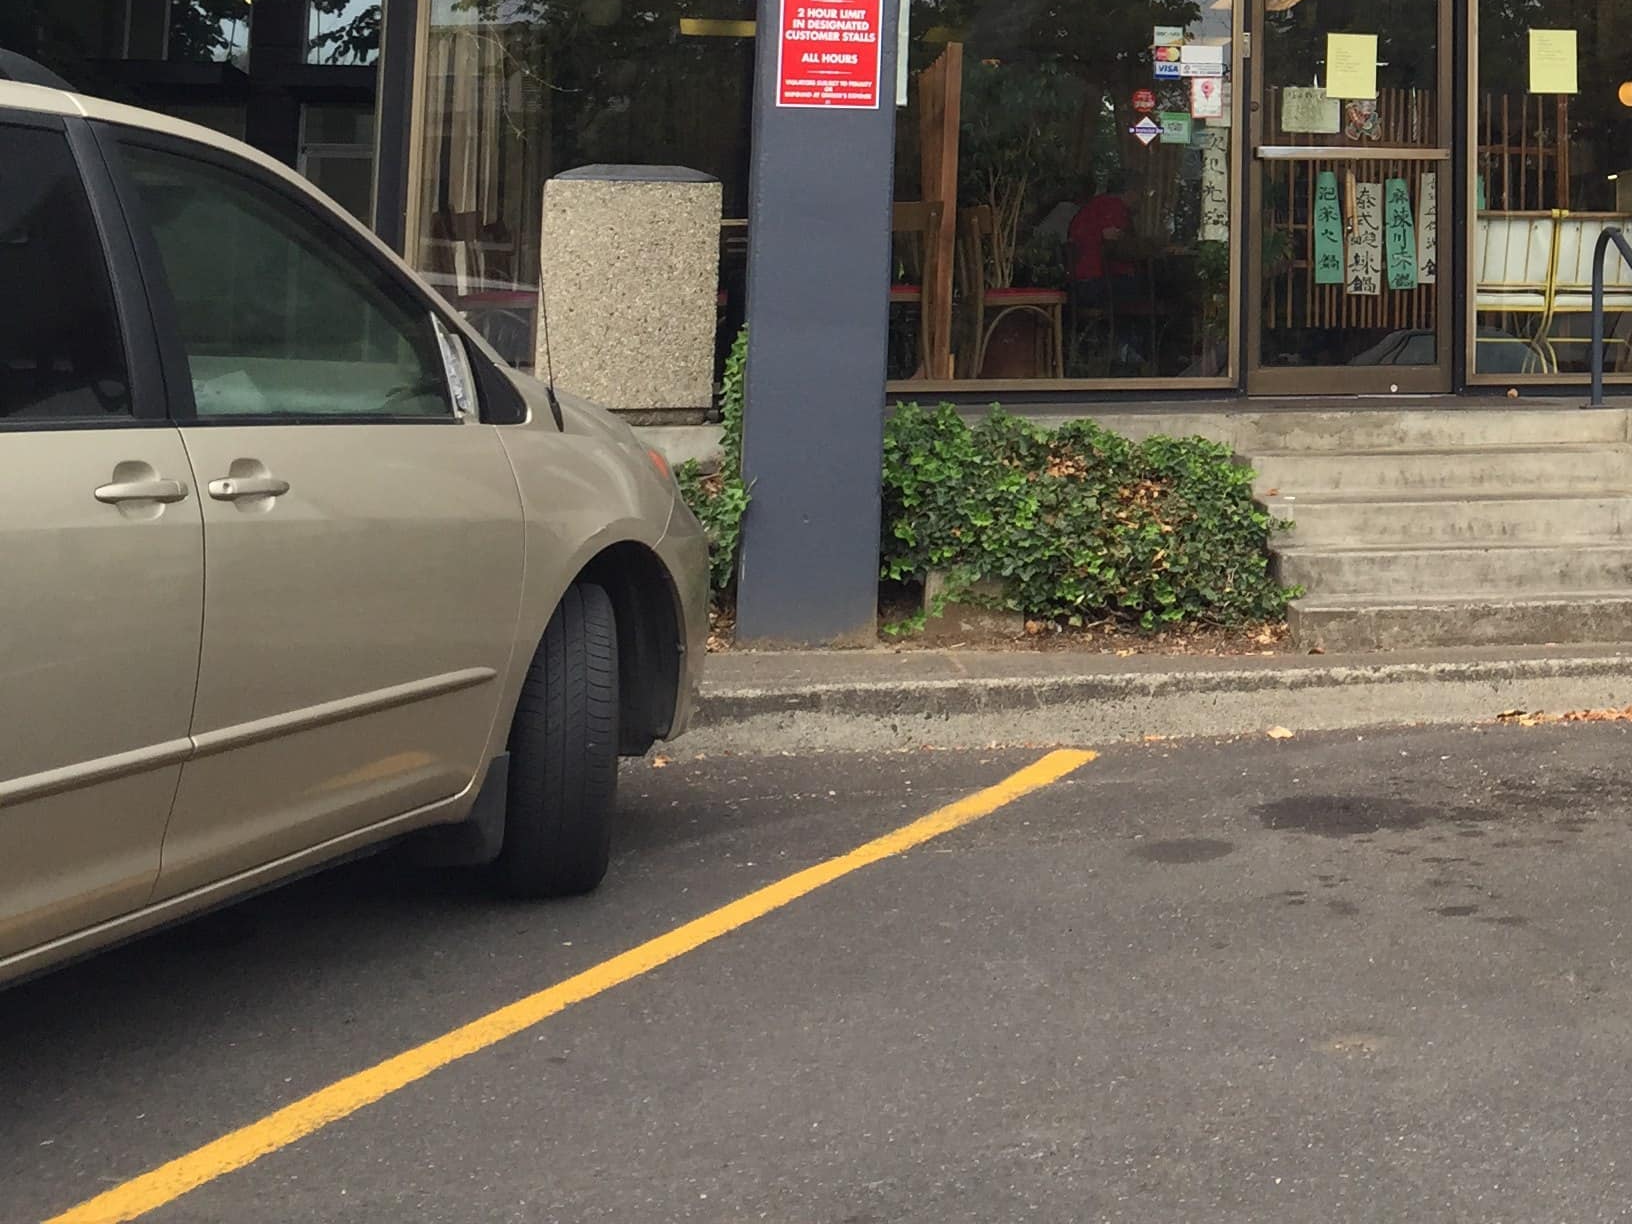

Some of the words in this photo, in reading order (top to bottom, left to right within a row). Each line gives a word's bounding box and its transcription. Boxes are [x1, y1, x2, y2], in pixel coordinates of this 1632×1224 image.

[797, 8, 805, 18] 2
[807, 8, 838, 19] HOUR
[840, 9, 866, 20] LIMIT
[792, 19, 806, 29] IN
[807, 20, 870, 31] DESIGNATED
[785, 30, 841, 41] CUSTOMER
[842, 31, 876, 42] STALLS
[801, 52, 820, 63] ALL
[821, 53, 858, 64] HOURS
[1159, 65, 1179, 73] VISA
